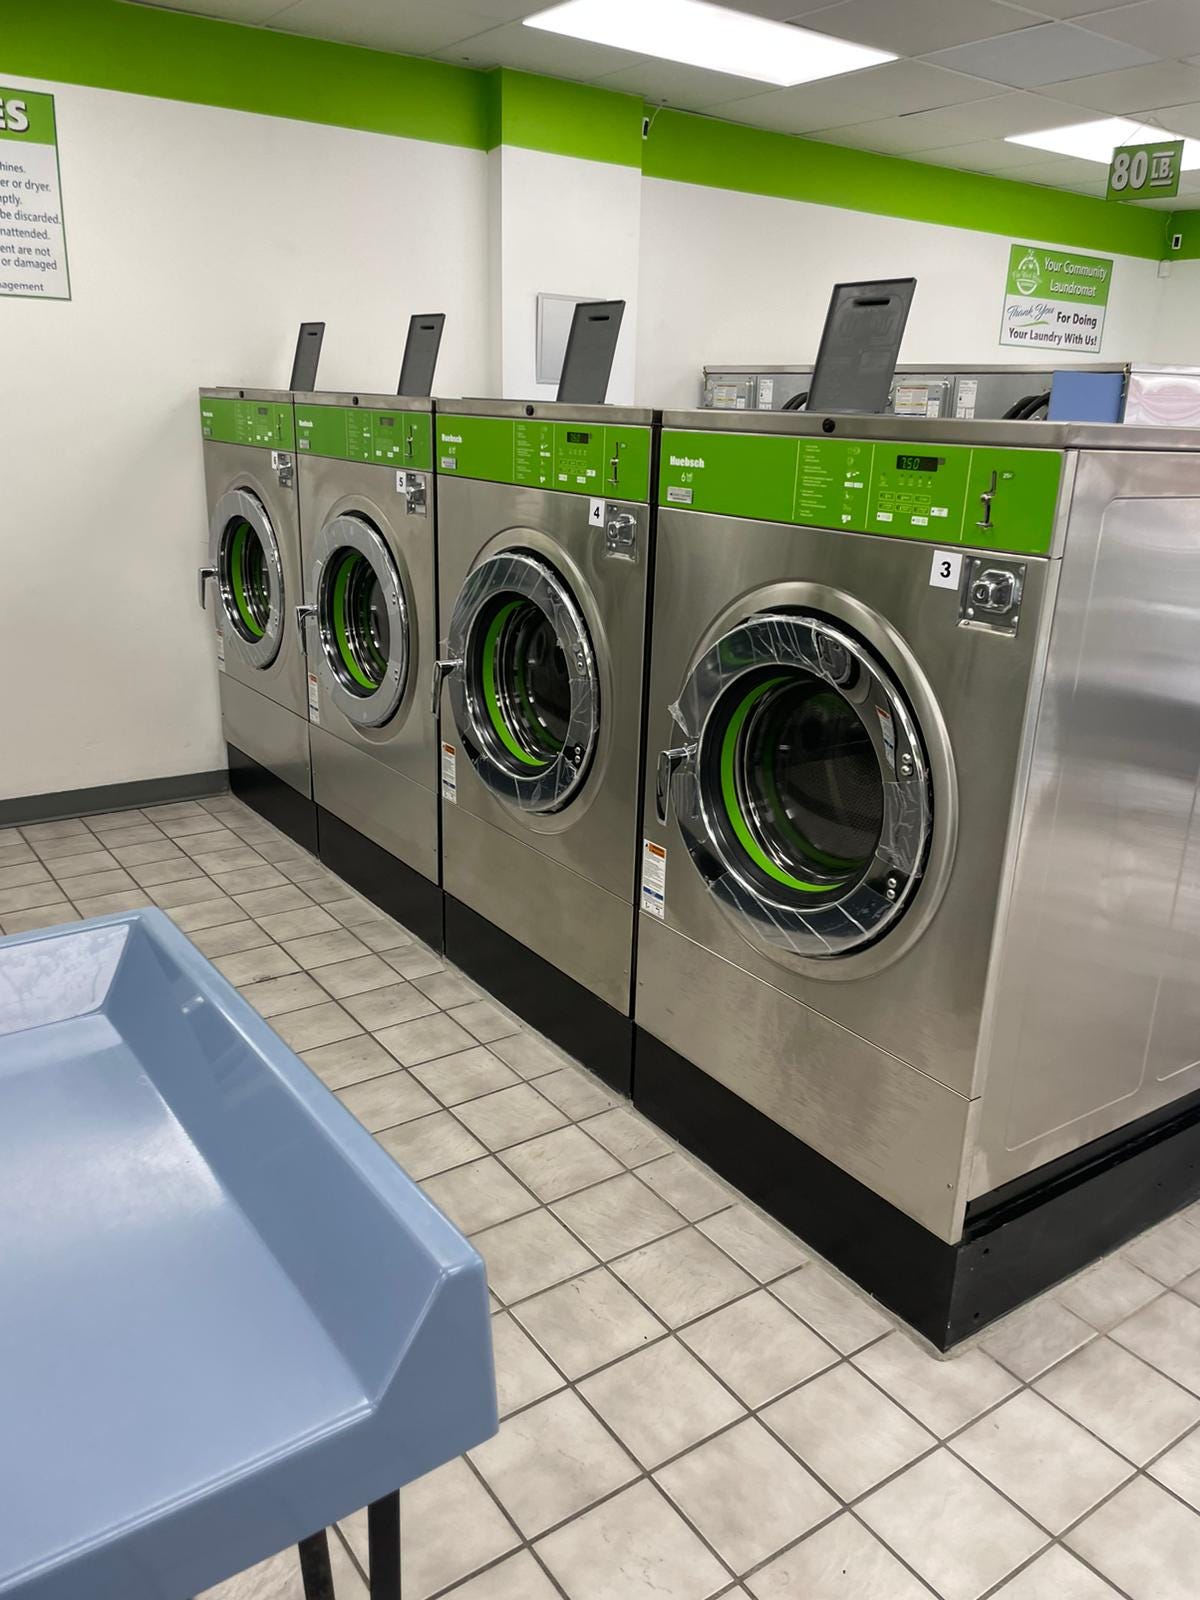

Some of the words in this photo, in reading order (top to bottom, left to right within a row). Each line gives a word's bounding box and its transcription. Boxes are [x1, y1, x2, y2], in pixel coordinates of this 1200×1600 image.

[0, 97, 29, 132] S
[1111, 151, 1148, 191] 80
[1151, 157, 1173, 179] LB.
[12, 180, 22, 188] or
[25, 179, 51, 194] dryer.
[0, 194, 22, 207] ptly.
[14, 210, 61, 225] discarded.
[18, 246, 32, 256] are
[35, 247, 51, 257] not
[1, 258, 11, 266] or
[14, 257, 57, 272] damaged
[1044, 257, 1063, 272] Your
[1063, 260, 1107, 282] Community
[0, 281, 44, 292] agement
[1050, 279, 1096, 298] Laundromat
[1007, 304, 1034, 321] Thank
[1034, 303, 1055, 321] You
[1056, 311, 1071, 324] For
[1072, 313, 1097, 330] Doing
[1009, 327, 1028, 340] Your
[1029, 330, 1062, 346] Laundry
[1064, 333, 1083, 345] With
[1084, 335, 1098, 346] Us!
[669, 455, 705, 468] Huebsch
[399, 476, 404, 488] 5
[593, 506, 600, 520] 4
[940, 561, 951, 578] 3
